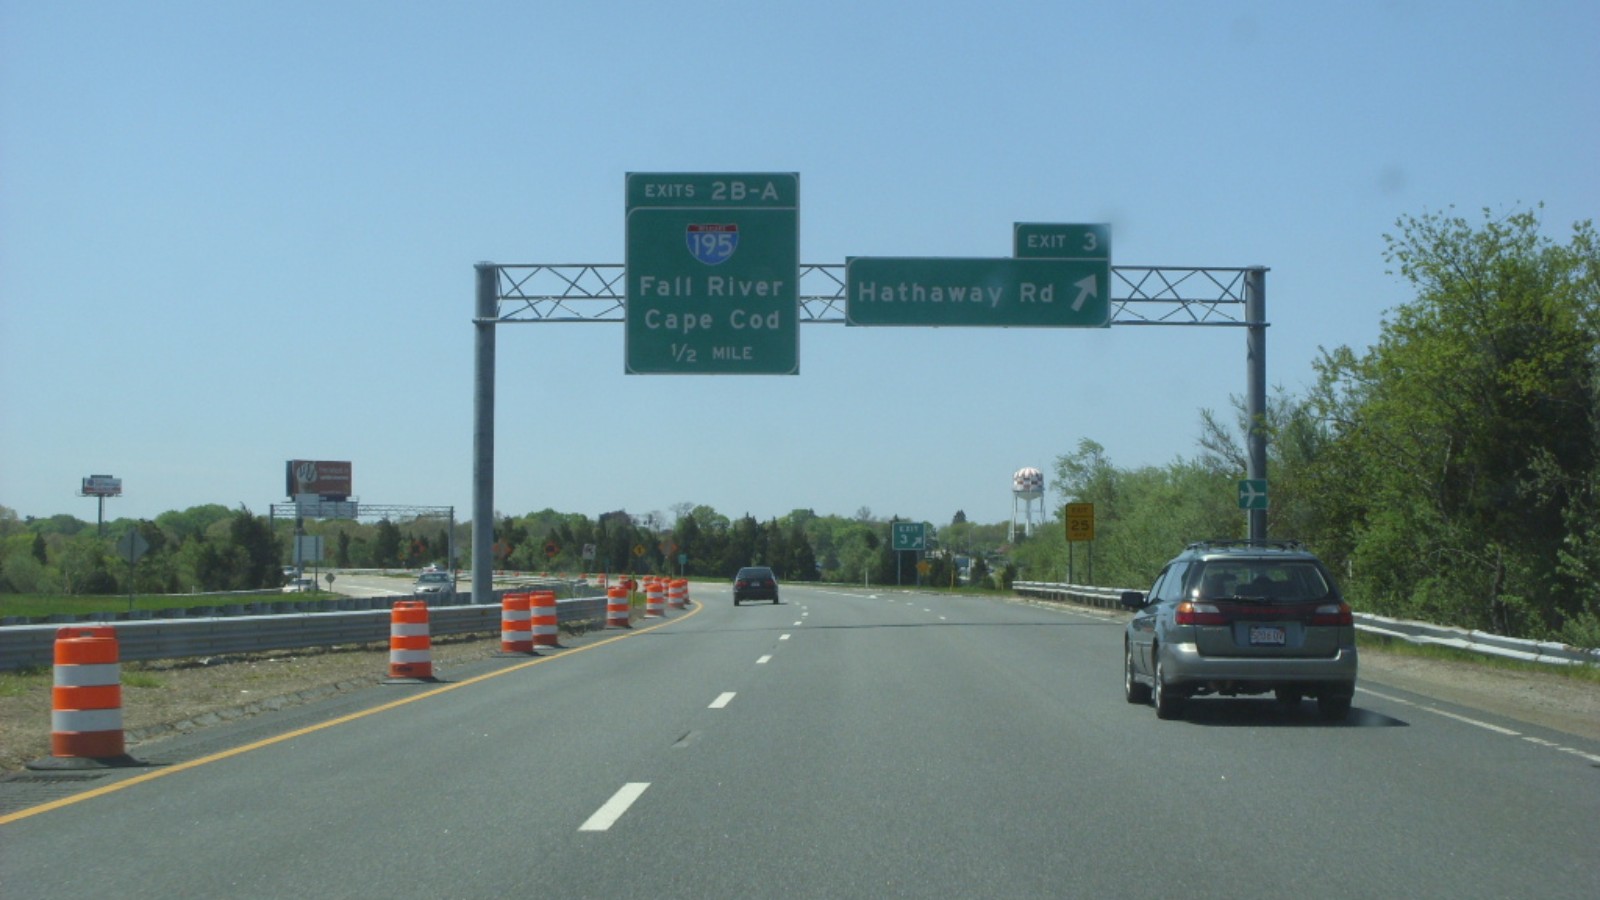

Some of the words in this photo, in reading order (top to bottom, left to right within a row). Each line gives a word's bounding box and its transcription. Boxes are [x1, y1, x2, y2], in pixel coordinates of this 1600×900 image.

[644, 184, 695, 198] EXITS
[711, 181, 779, 201] 2B-A
[693, 233, 733, 257] 195
[1027, 234, 1066, 249] EXIT
[1082, 232, 1097, 251] 3
[639, 276, 692, 297] Fall
[707, 276, 784, 297] River
[858, 282, 1003, 308] Hathaway
[1019, 282, 1054, 303] Rd
[644, 309, 713, 335] Cape
[729, 309, 780, 330] Cod
[712, 346, 753, 360] MILE
[1071, 519, 1090, 531] 25
[900, 534, 908, 545] 3
